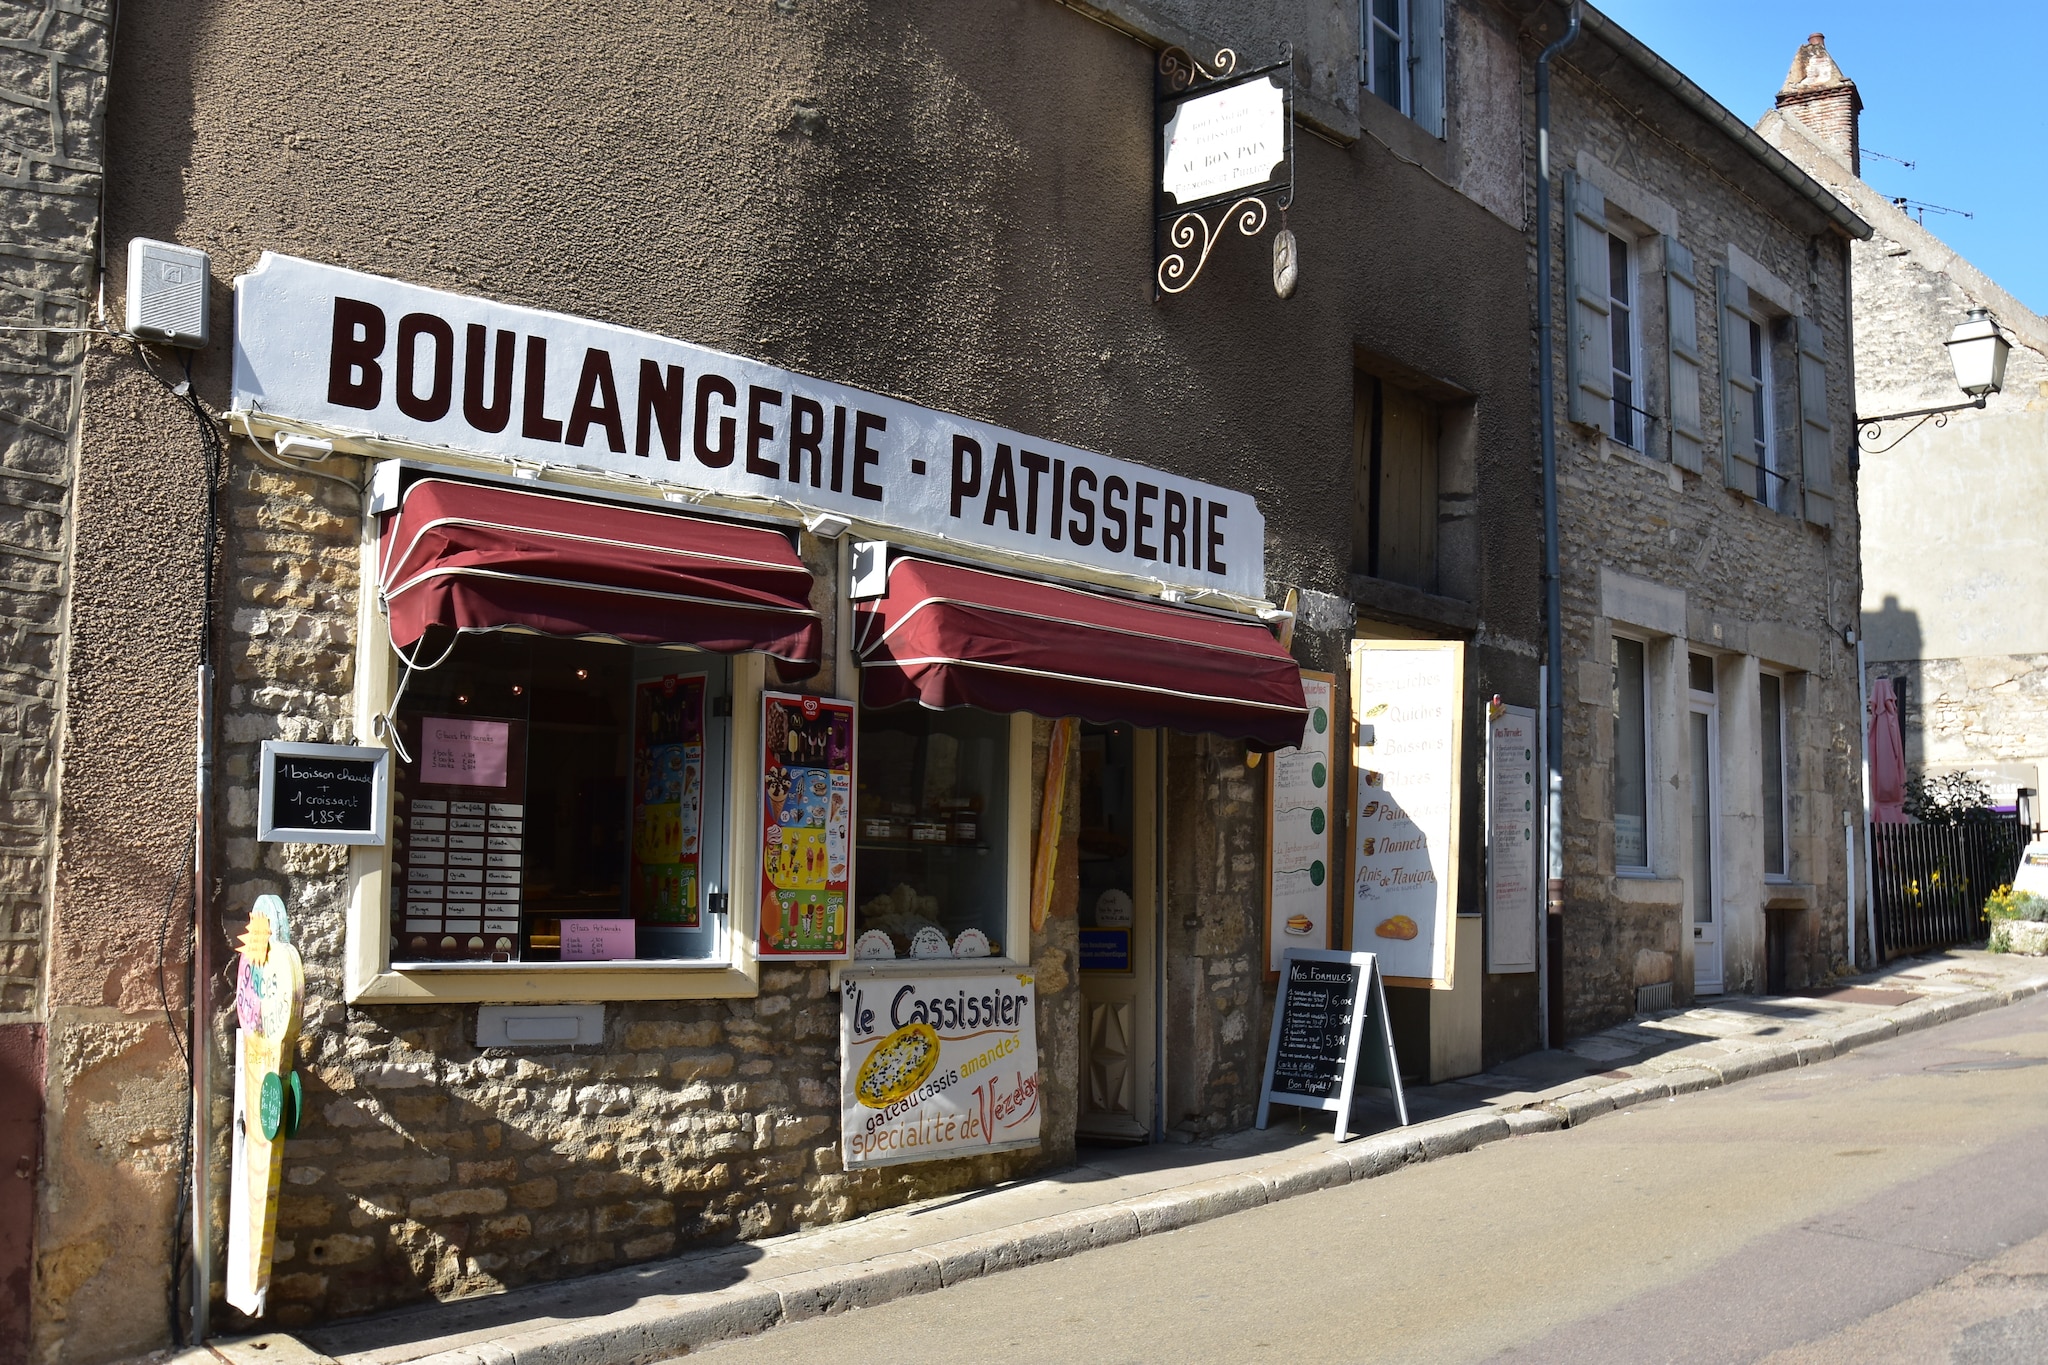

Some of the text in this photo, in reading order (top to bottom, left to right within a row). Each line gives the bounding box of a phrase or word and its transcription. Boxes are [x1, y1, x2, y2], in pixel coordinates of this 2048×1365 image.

[327, 294, 888, 502] BOULANGERIE
[949, 433, 1229, 576] PATISSERIE
[1390, 704, 1442, 722] Quiches
[278, 764, 372, 784] 1 boisson chaude
[1384, 771, 1431, 787] Glaces
[290, 791, 358, 808] 1 croissant
[305, 810, 345, 825] 1,85€
[1356, 866, 1382, 883] Anis
[1380, 876, 1391, 887] de
[853, 985, 1028, 1036] le Cassissier
[918, 1069, 959, 1102] cassis
[960, 1034, 1020, 1080] amandes
[1288, 1078, 1302, 1089] Bon
[960, 1108, 980, 1140] de
[971, 1071, 1039, 1144] Vézelay
